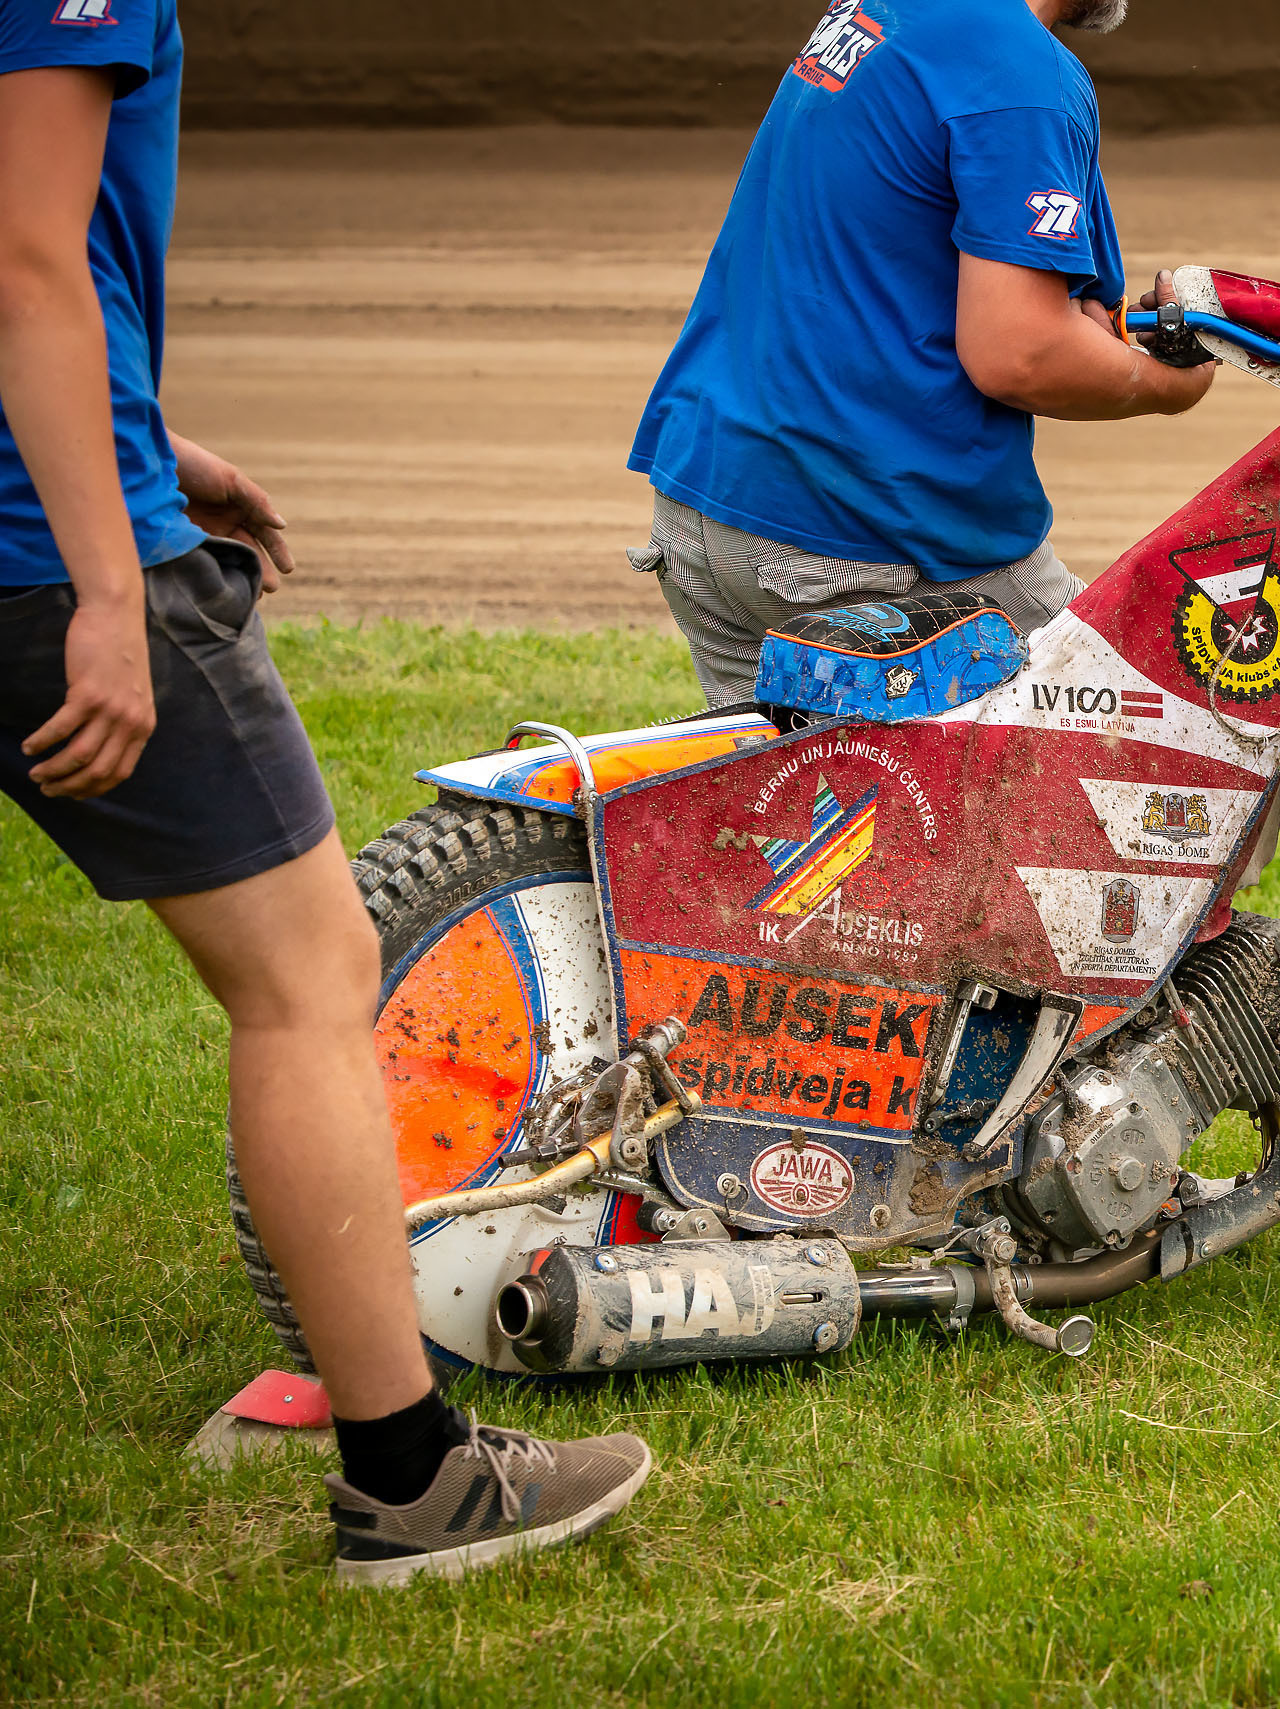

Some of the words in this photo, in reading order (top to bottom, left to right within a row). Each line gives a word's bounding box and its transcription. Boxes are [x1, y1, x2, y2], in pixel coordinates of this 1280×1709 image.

[1236, 668, 1270, 682] klubs
[1060, 718, 1071, 728] ES
[1076, 719, 1097, 729] ESMU
[1102, 720, 1136, 732] LATVIJA
[754, 759, 798, 814] BĒRNU
[802, 744, 824, 764] UN
[826, 740, 900, 773] JAUNIEŠU
[900, 770, 938, 840] CENTRS
[1142, 842, 1173, 856] RĪGAS
[1178, 846, 1210, 858] DOME
[812, 887, 924, 946] AUSEKLIS
[758, 922, 780, 943] IK
[772, 1154, 833, 1182] JAWA
